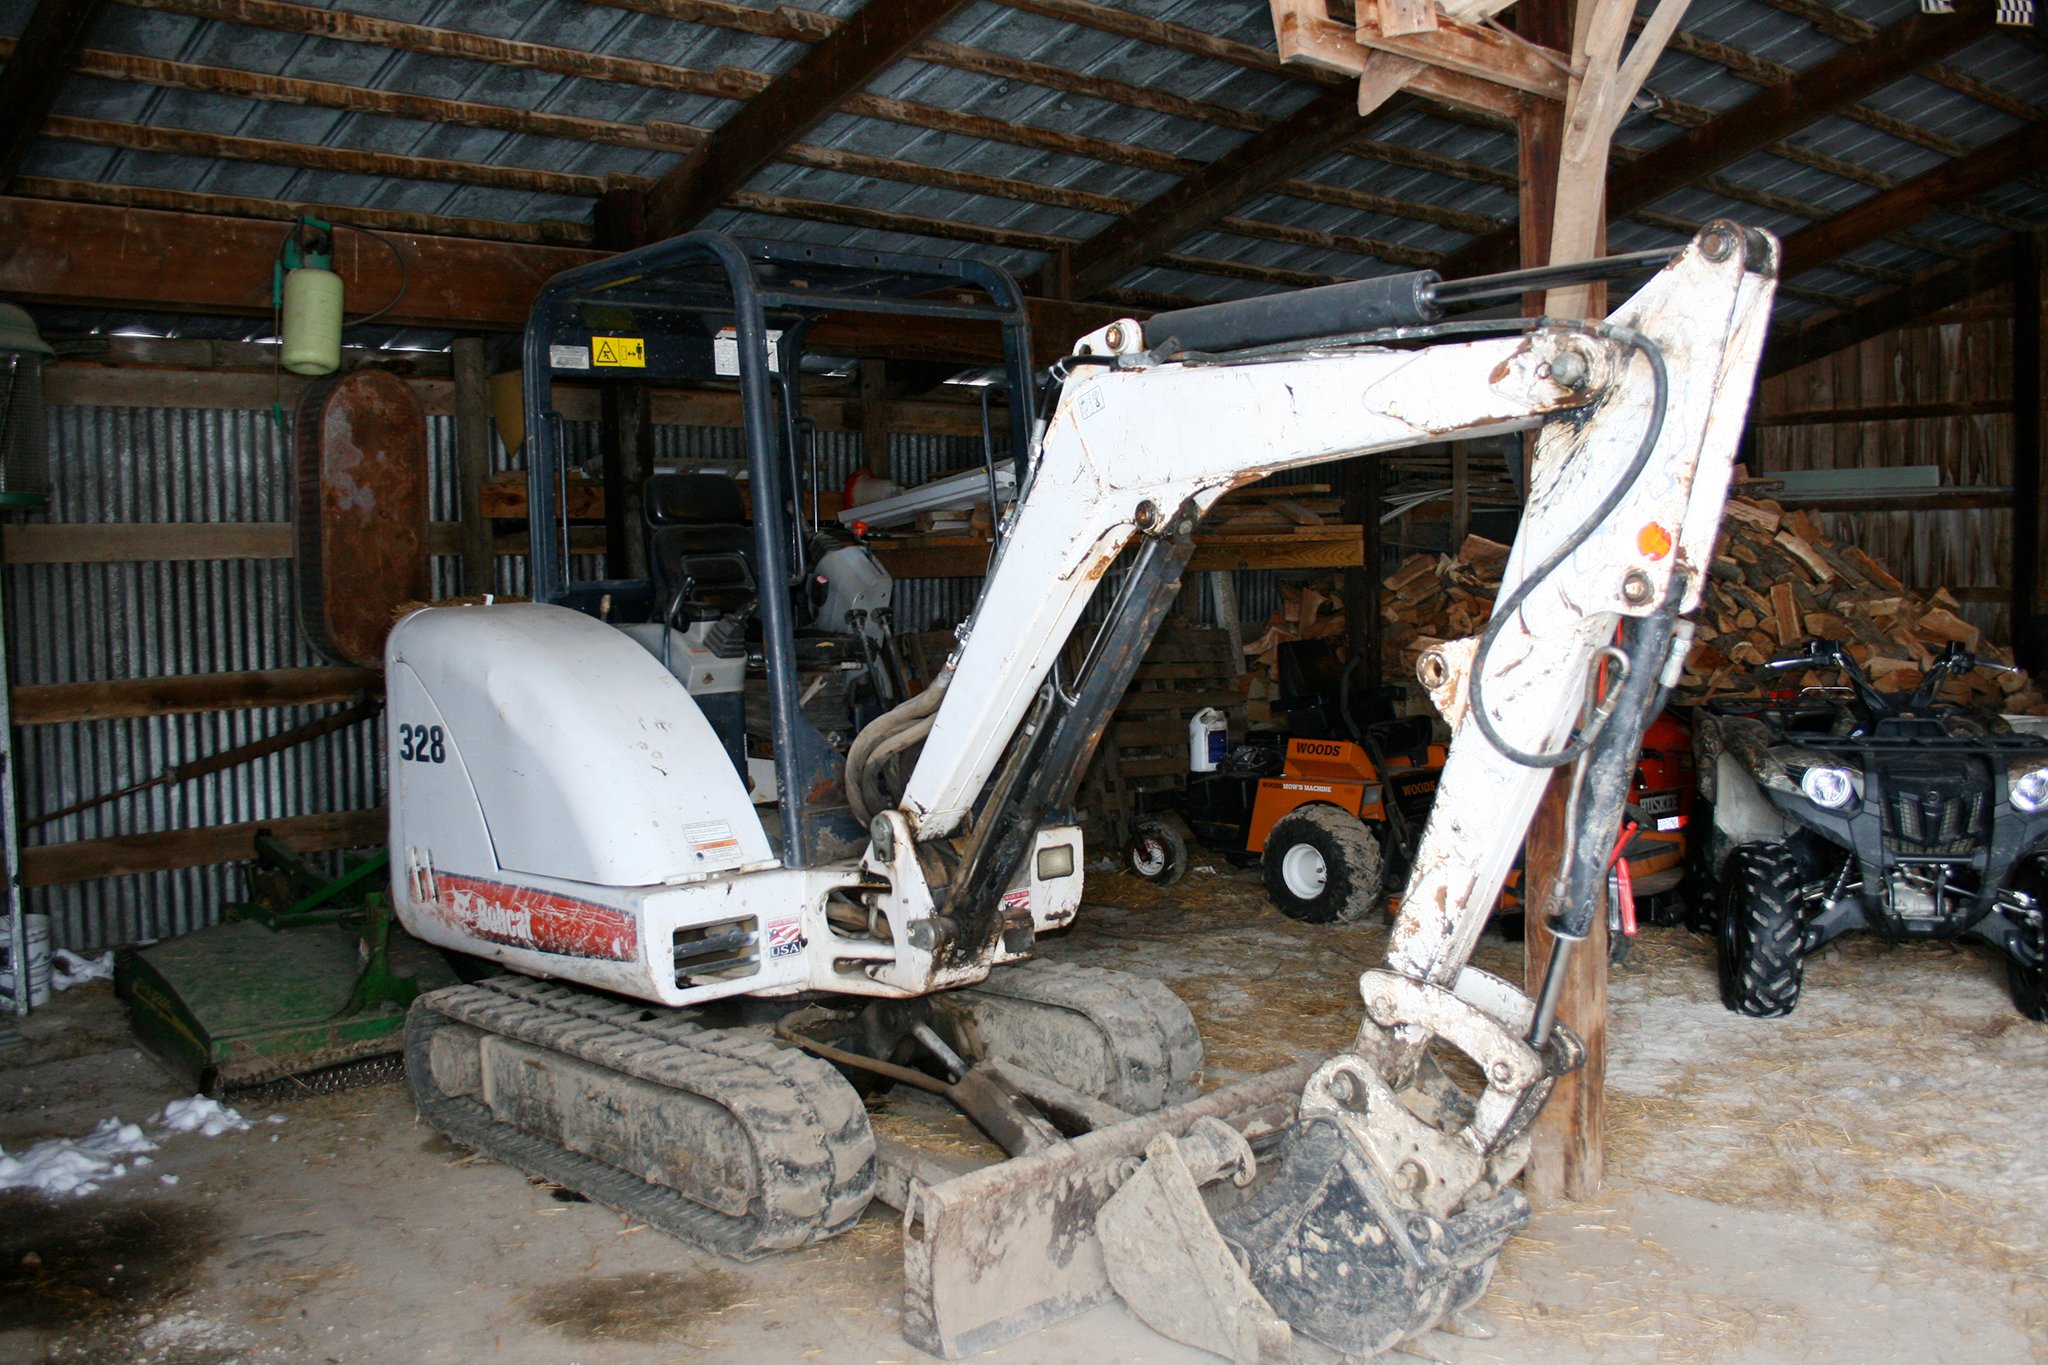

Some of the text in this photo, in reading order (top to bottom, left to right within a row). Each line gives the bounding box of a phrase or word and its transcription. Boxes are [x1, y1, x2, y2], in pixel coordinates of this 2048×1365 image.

[399, 723, 446, 764] 328
[1296, 742, 1341, 757] WOODS
[1304, 784, 1332, 793] MACHINE
[1401, 780, 1437, 797] WOODS
[1639, 794, 1679, 815] HUSKEE
[475, 898, 534, 941] Bobcat
[771, 941, 801, 957] USA
